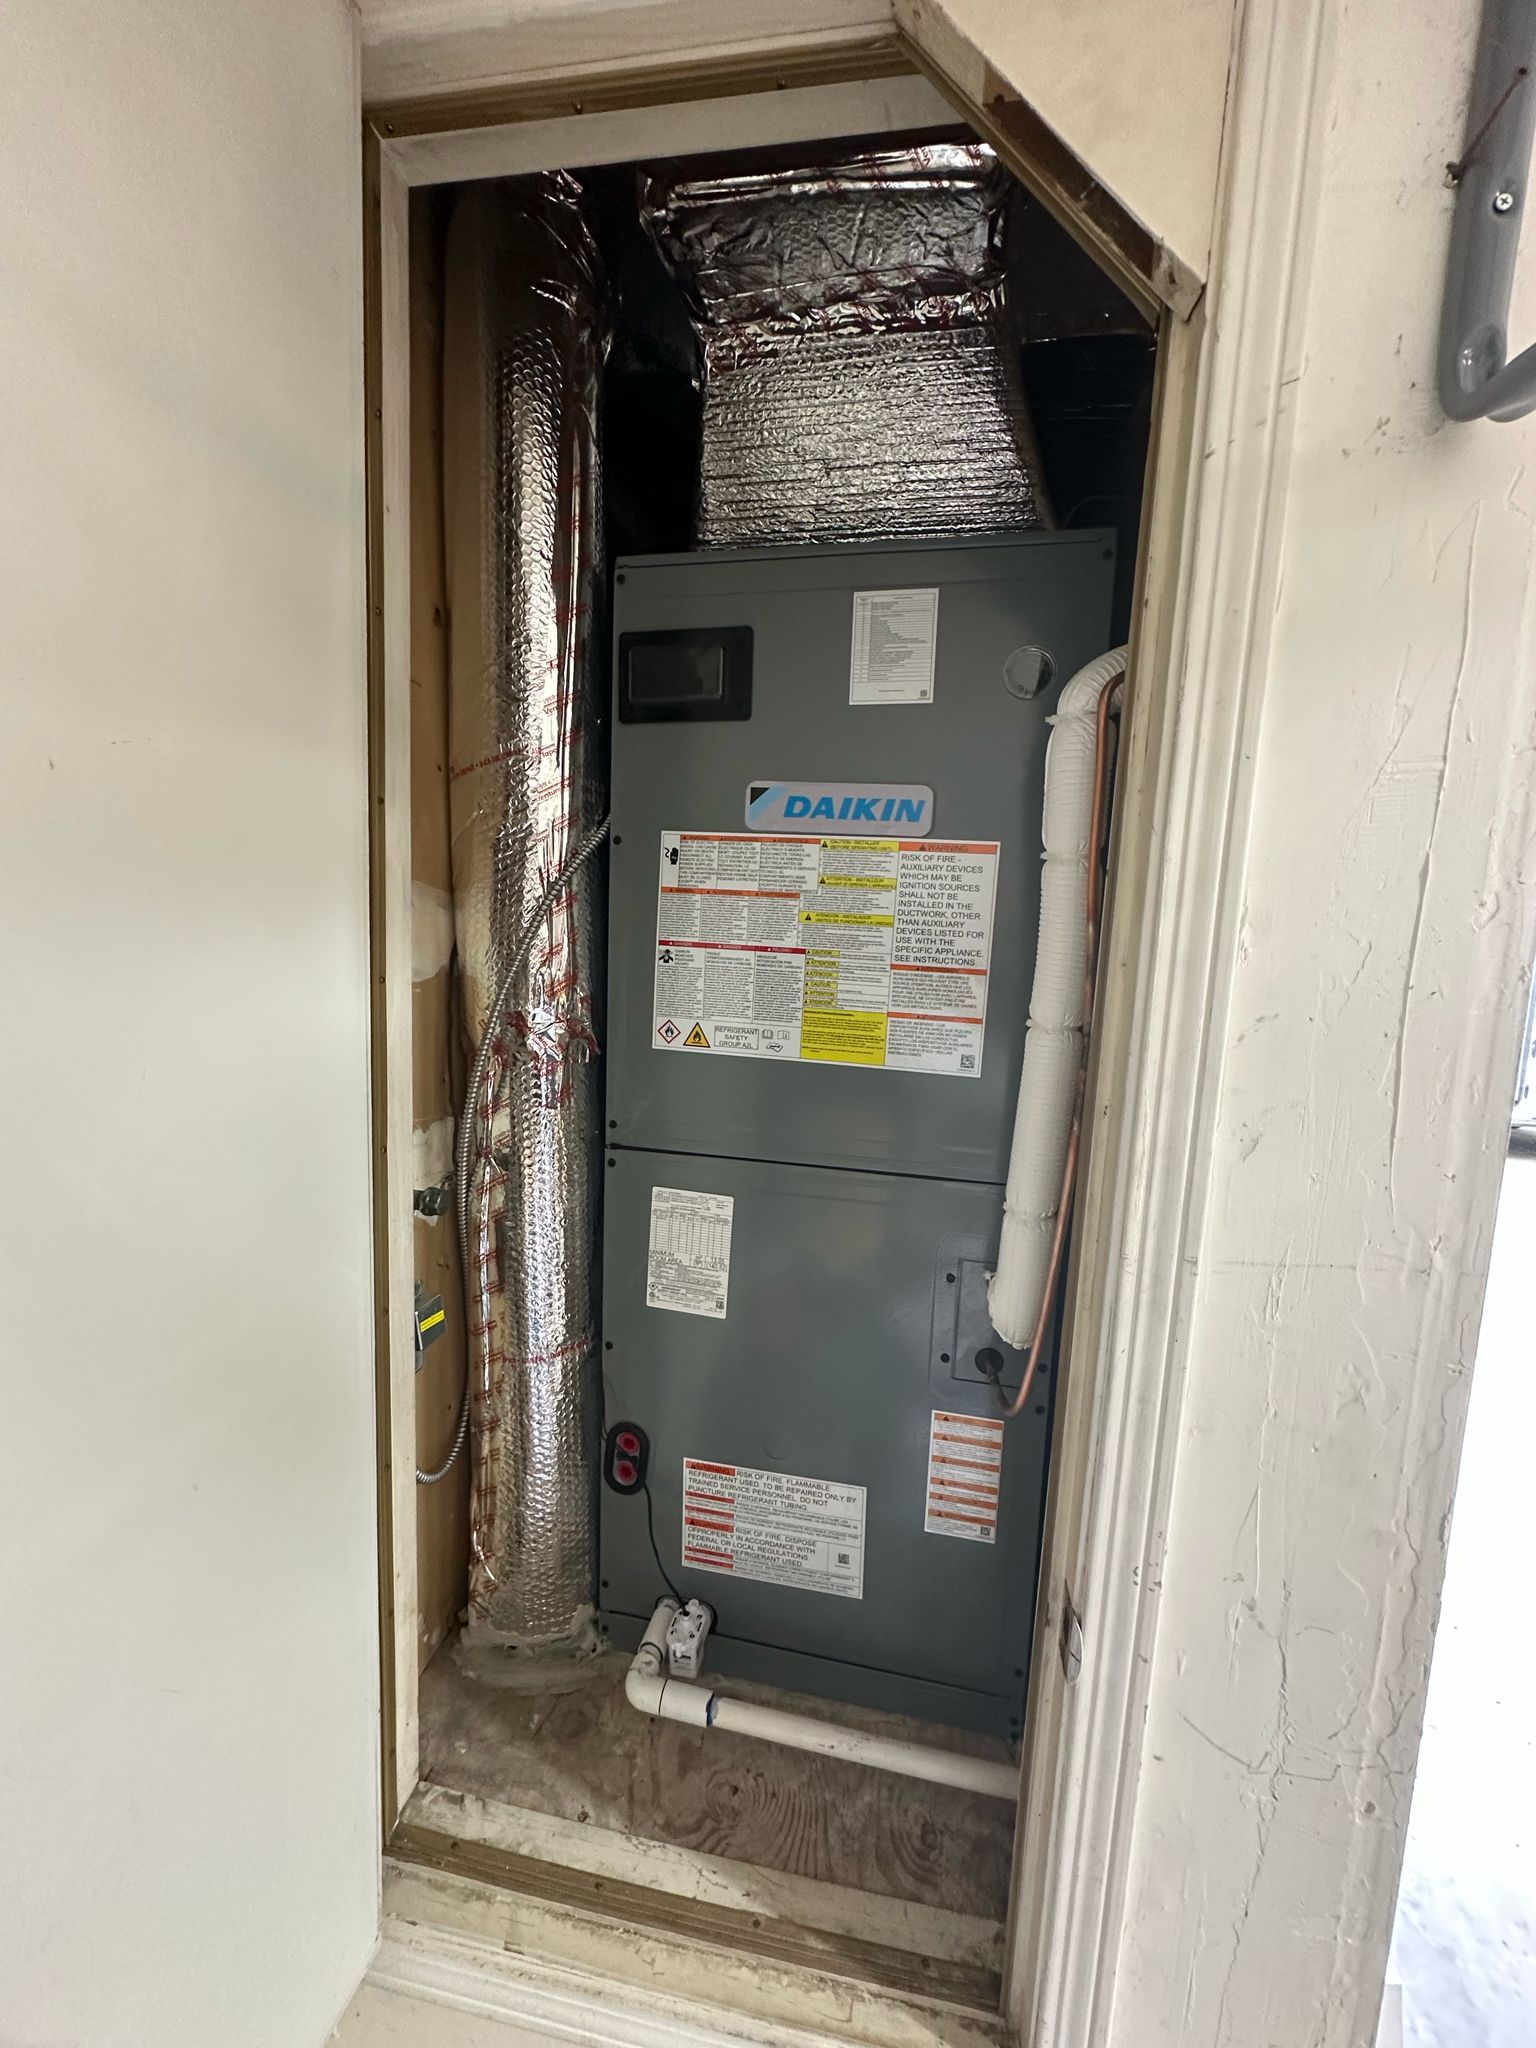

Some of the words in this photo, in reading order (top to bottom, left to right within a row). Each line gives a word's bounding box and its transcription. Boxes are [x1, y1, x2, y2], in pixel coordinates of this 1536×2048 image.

[783, 795, 926, 823] DAIKIN
[937, 855, 956, 863] FIRE
[901, 863, 944, 872] AUXILIARY
[946, 865, 983, 873] DEVICES
[951, 874, 962, 882] BE
[899, 882, 936, 890] IGNITION
[938, 883, 980, 892] SOURCES
[899, 891, 924, 899] SHALL
[927, 892, 945, 900] NOT
[898, 900, 943, 909] INSTALLED
[957, 902, 973, 910] THE
[951, 911, 980, 920] OTHER
[897, 918, 920, 927] THAN
[921, 919, 965, 929] AUXILIARY
[896, 927, 932, 936] DEVICES
[934, 929, 964, 938] LISTED
[966, 931, 984, 939] FOR
[896, 936, 912, 944] USE
[939, 938, 955, 946] THE
[895, 945, 933, 954] SPECIFIC
[894, 955, 911, 963] SEE
[715, 1026, 758, 1035] REFRIGERANT
[688, 1470, 738, 1484] REFRIGERANT
[774, 1483, 784, 1491] BE
[786, 1485, 823, 1498] REPAIRED
[824, 1492, 846, 1502] ONLY
[846, 1495, 857, 1503] BY
[736, 1471, 753, 1479] RISK
[754, 1473, 765, 1481] OF
[786, 1478, 830, 1492] FLAMMABLE
[688, 1478, 719, 1488] TRAINED
[720, 1482, 751, 1494] SERVICE
[812, 1498, 828, 1507] NOT
[688, 1485, 727, 1497] PUNCTURE
[728, 1491, 778, 1506] REFRIGERANT
[688, 1533, 720, 1545] FEDERAL
[720, 1539, 731, 1547] OR
[732, 1541, 756, 1551] LOCAL
[735, 1528, 752, 1536] RISK
[753, 1530, 764, 1538] OF
[785, 1536, 817, 1548] DISPOSE
[743, 1536, 795, 1551] ACCORDANCE
[796, 1545, 816, 1554] WITH
[687, 1540, 730, 1552] FLAMMABLE
[730, 1548, 780, 1563] REFRIGERANT
